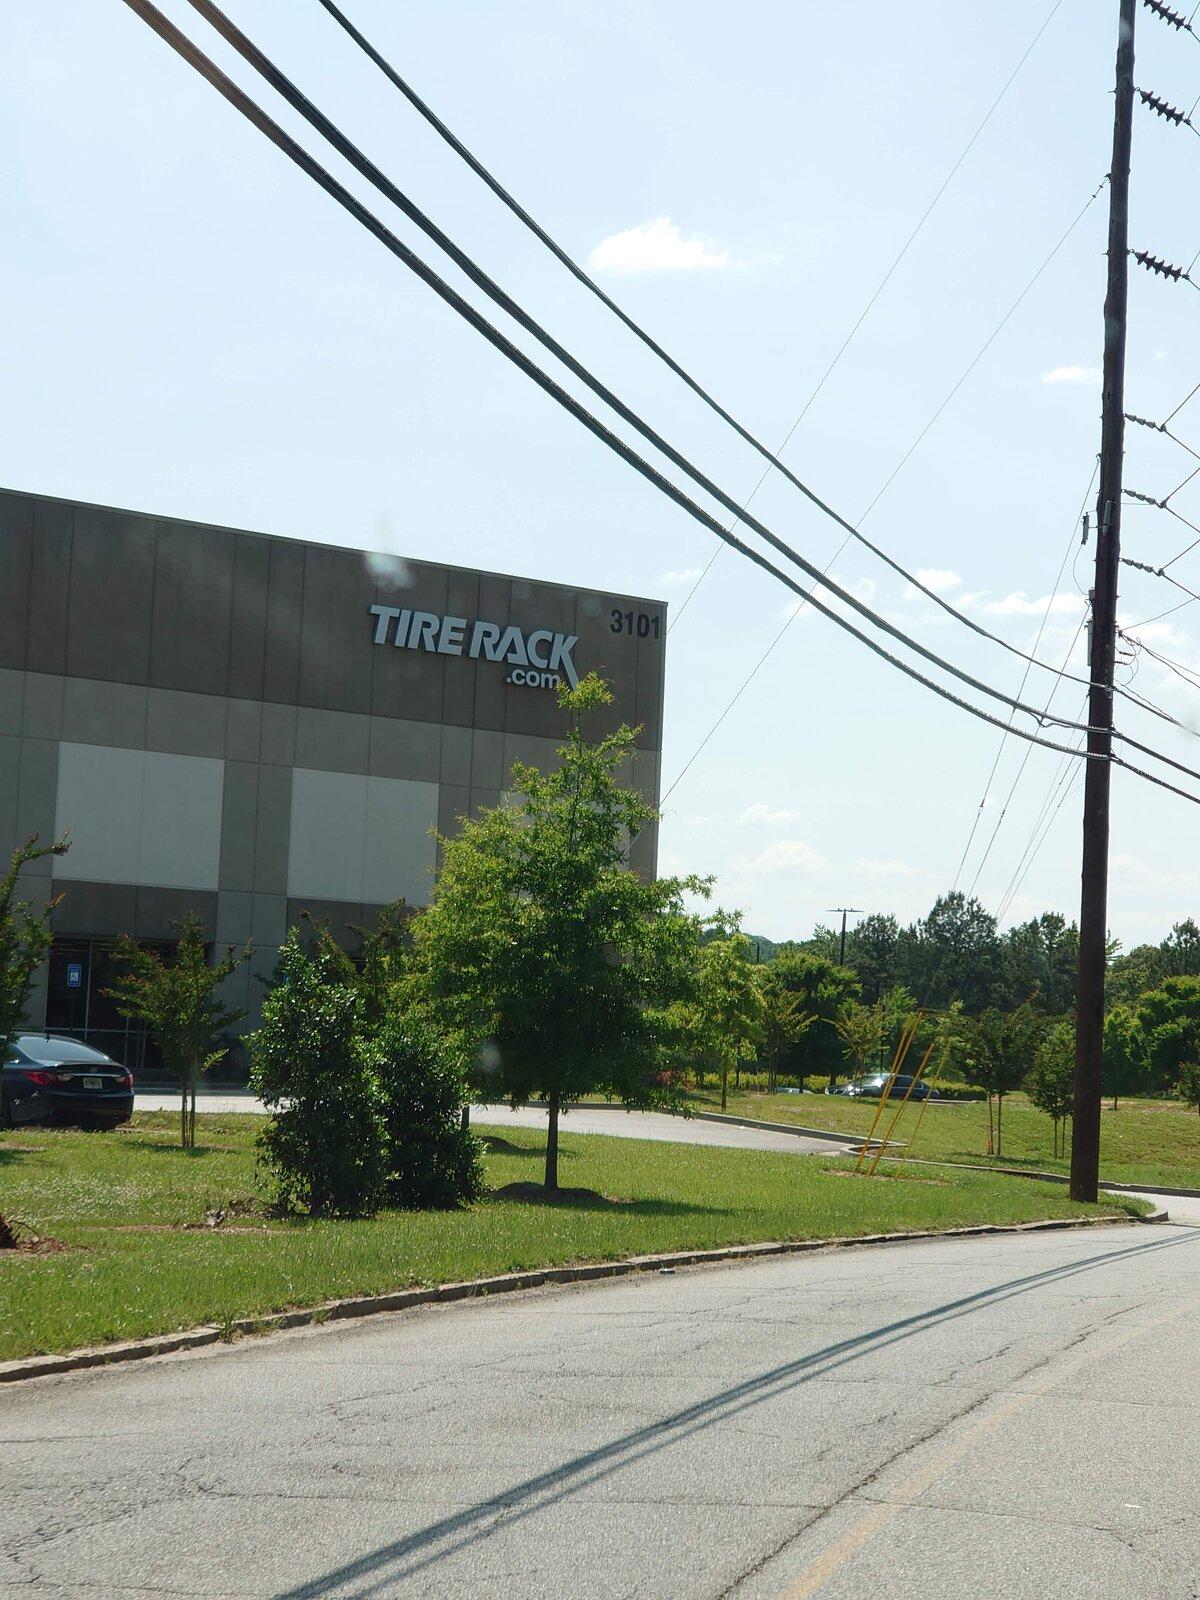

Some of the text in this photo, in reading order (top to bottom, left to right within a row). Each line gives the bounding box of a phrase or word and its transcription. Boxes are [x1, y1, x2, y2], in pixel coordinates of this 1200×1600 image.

[609, 608, 660, 639] 3101
[370, 604, 579, 690] TIRE RACK
[506, 668, 561, 689] .com
